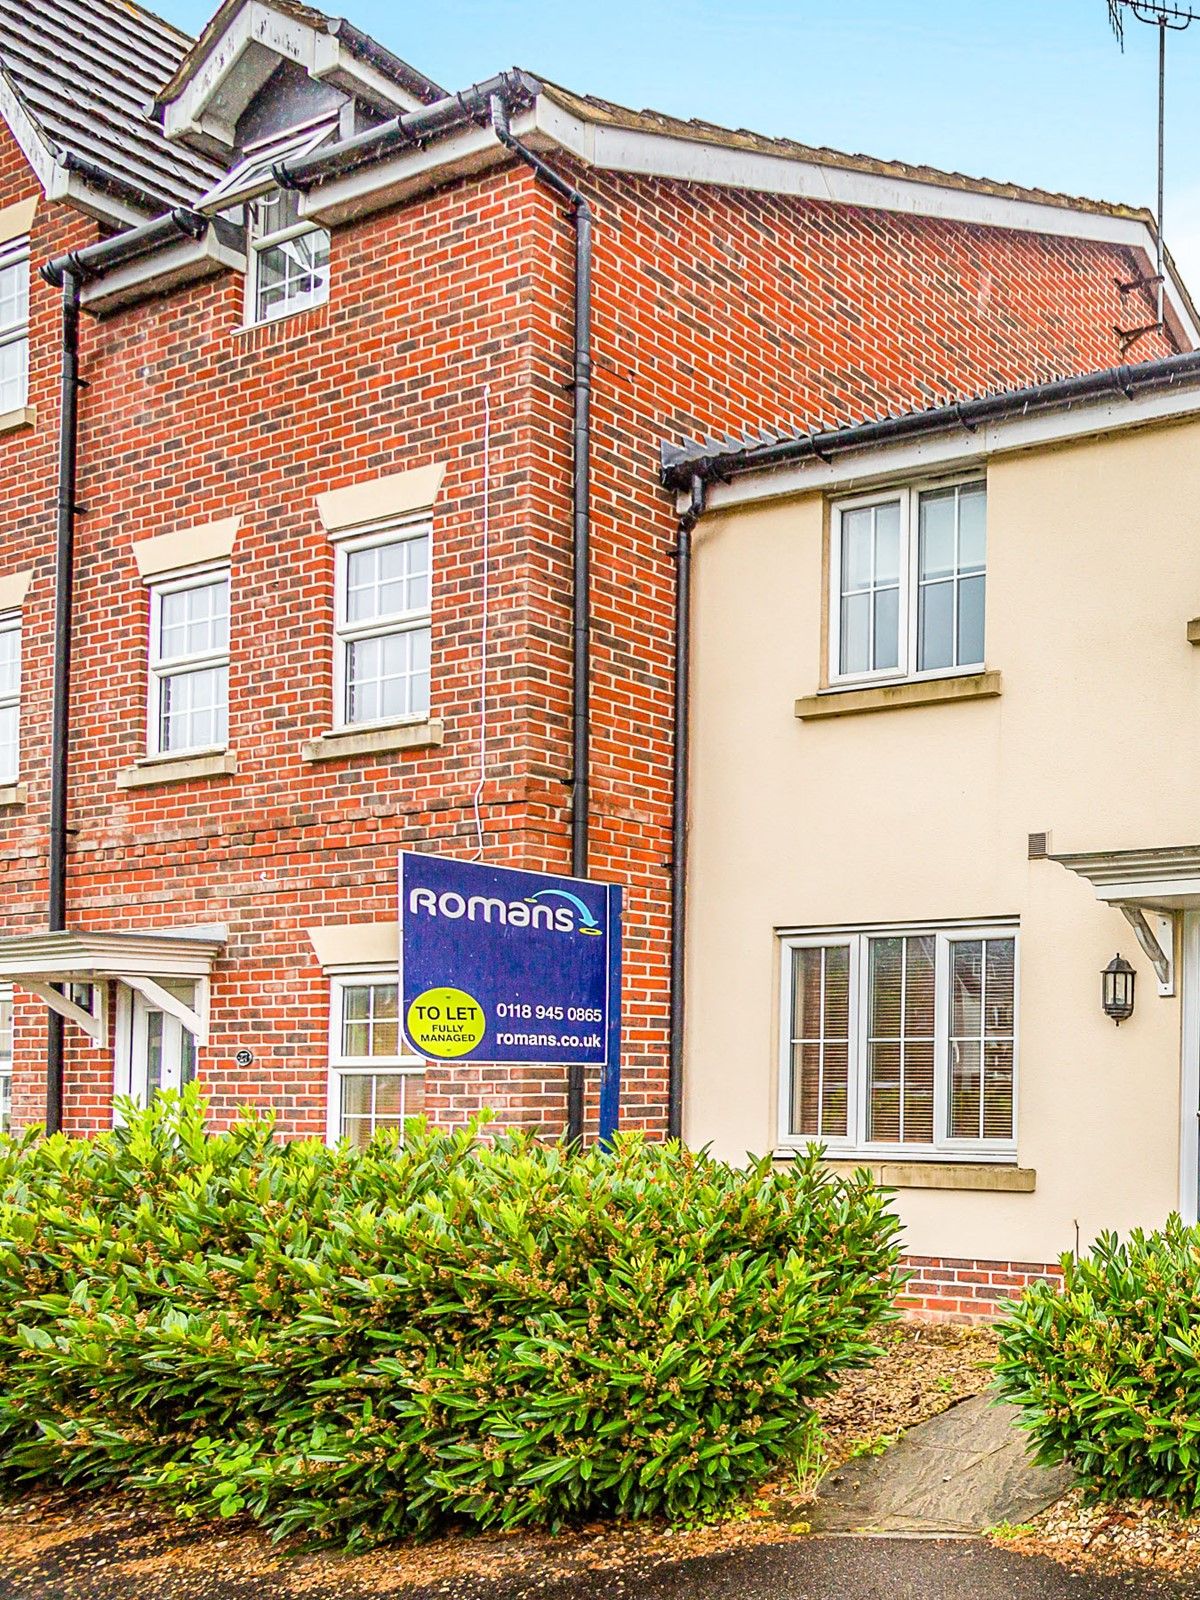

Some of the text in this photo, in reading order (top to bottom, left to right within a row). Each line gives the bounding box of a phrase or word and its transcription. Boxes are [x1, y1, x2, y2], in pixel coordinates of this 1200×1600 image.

[415, 1006, 478, 1020] TO LET
[496, 1003, 602, 1022] 0118 945 0865
[432, 1024, 464, 1033] FULLY
[420, 1034, 476, 1042] MANAGED
[496, 1033, 602, 1047] romans.co.uk
